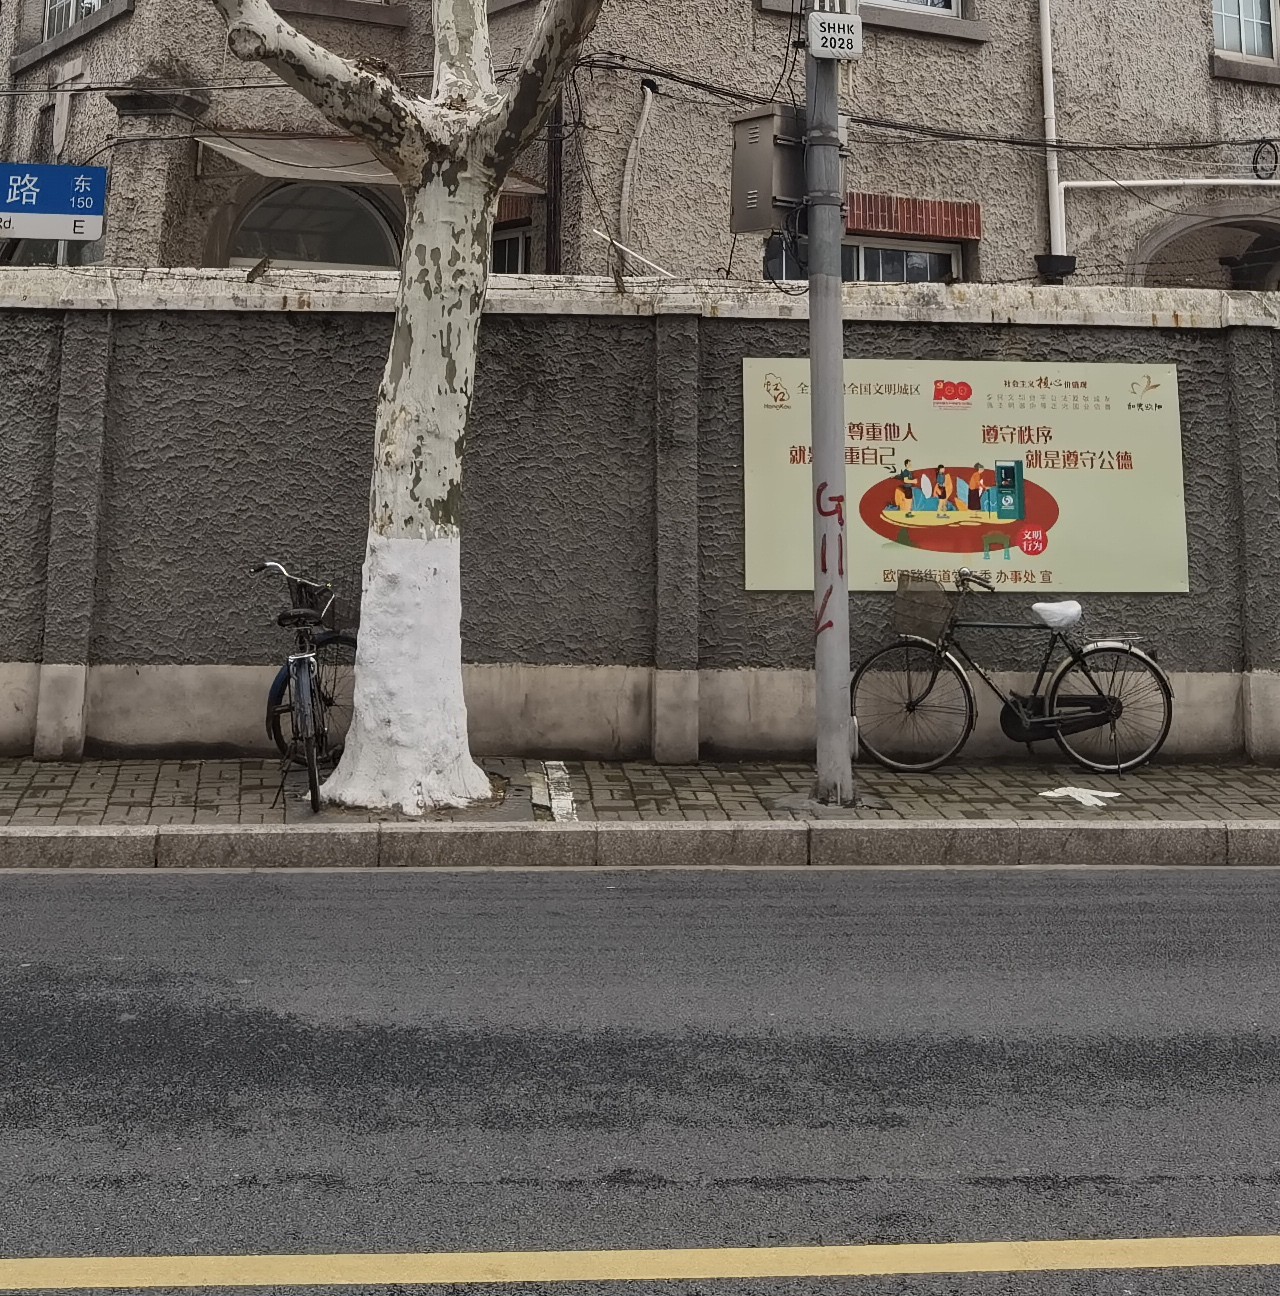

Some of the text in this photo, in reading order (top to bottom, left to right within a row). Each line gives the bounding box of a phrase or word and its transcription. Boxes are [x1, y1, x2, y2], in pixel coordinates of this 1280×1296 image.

[819, 21, 855, 35] SHHK
[820, 36, 854, 50] 2028
[74, 174, 93, 193] 东
[70, 196, 94, 210] 150
[73, 219, 86, 235] E
[981, 424, 1053, 445] 遵守秩序
[1024, 449, 1134, 470] 就是遵守公德
[1022, 530, 1043, 541] 文明
[1022, 541, 1043, 552] 行为
[996, 569, 1037, 584] 办事处
[1040, 570, 1053, 584] 宣
